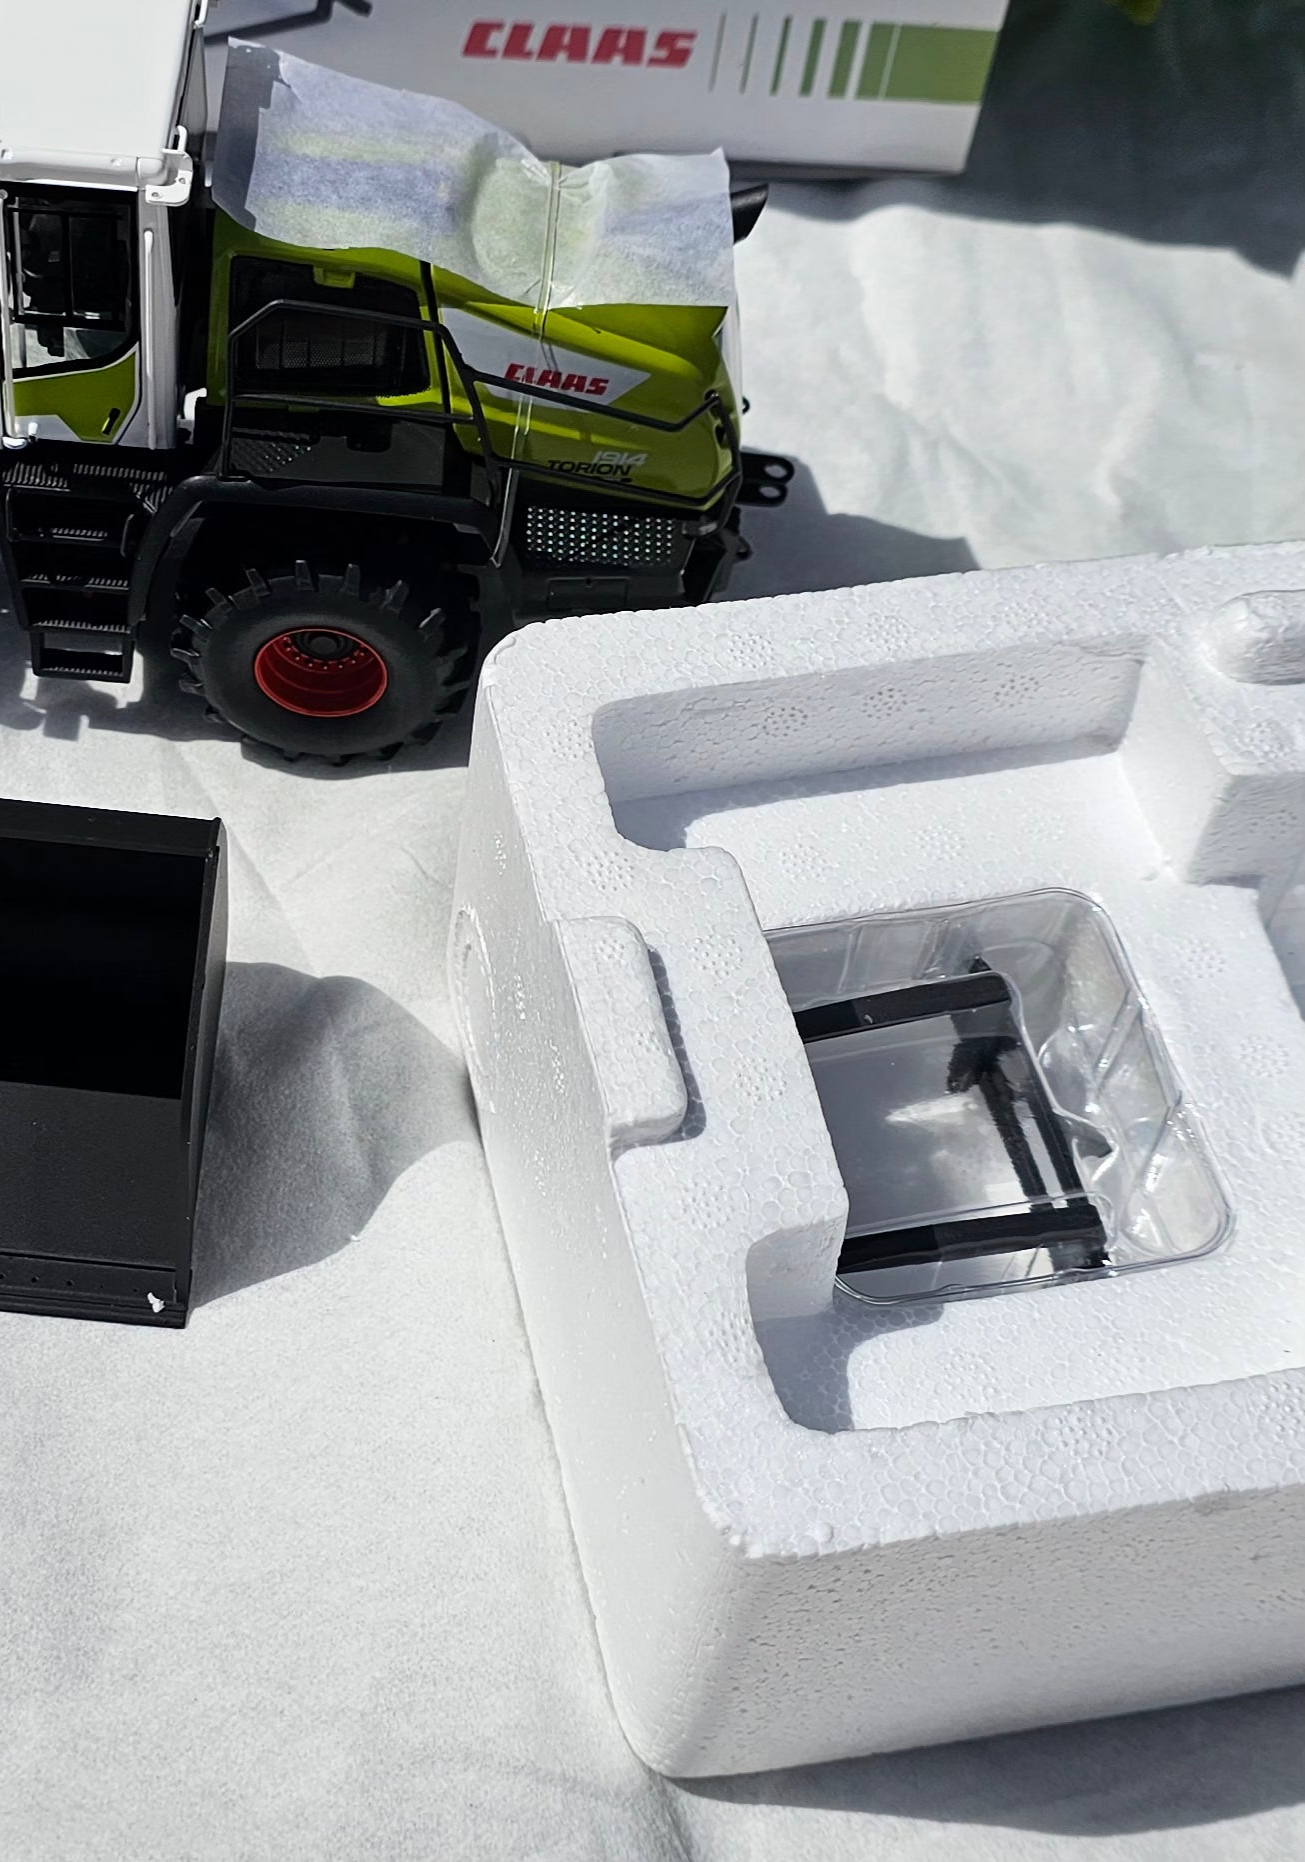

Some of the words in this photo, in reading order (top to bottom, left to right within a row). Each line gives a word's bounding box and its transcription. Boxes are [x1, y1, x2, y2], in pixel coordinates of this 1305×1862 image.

[462, 21, 698, 69] CLAAS
[504, 363, 609, 396] CLAAS
[547, 459, 632, 476] TORION
[592, 450, 648, 467] 1914
